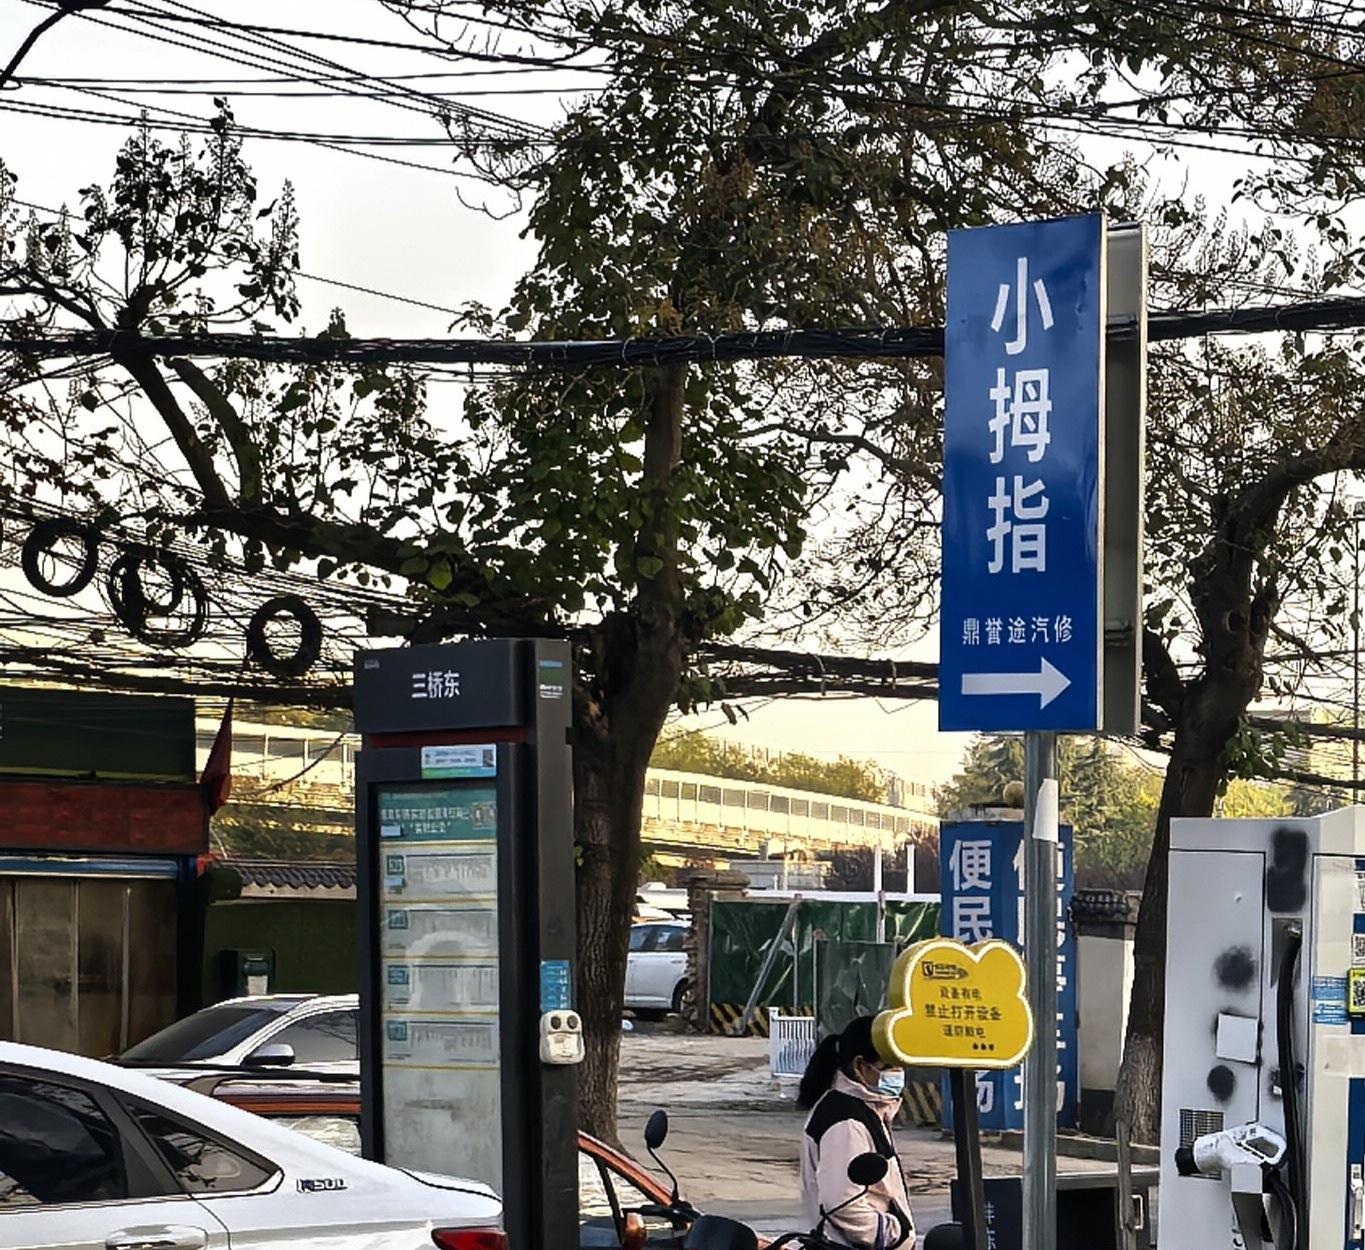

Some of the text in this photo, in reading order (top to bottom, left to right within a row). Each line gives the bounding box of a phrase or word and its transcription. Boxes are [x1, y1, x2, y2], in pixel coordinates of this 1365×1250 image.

[987, 256, 1055, 575] 小拇指
[961, 614, 1074, 648] 鼎誉途汽修
[411, 670, 460, 699] 三桥东
